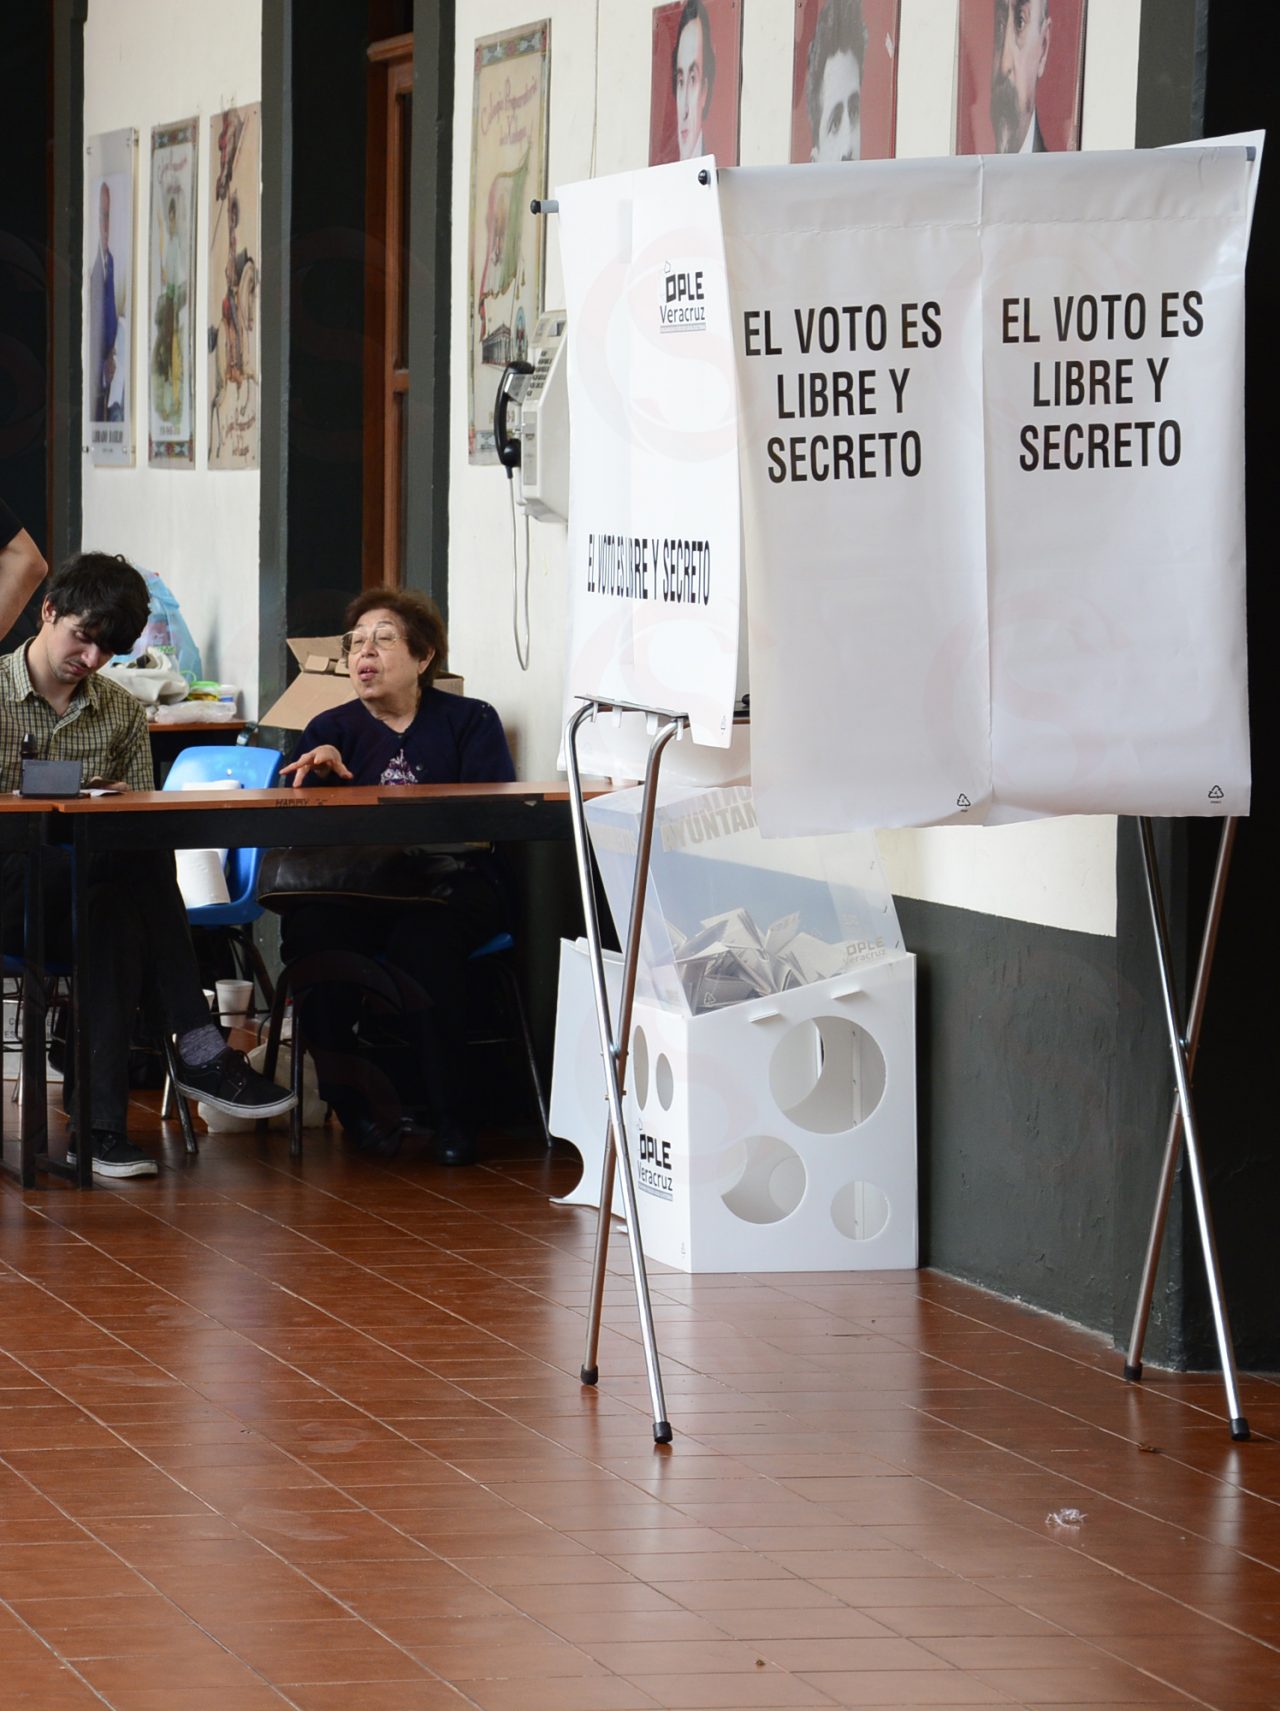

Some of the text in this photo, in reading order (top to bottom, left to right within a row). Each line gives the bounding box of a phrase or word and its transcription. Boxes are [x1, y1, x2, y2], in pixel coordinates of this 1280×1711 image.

[666, 271, 705, 303] OPLE
[660, 305, 705, 323] Veracruz
[744, 301, 942, 356] EL VOTO ES
[1002, 290, 1204, 344] EL VOTO ES
[777, 367, 911, 419] LIBRE Y
[1033, 357, 1170, 407] LIBRE Y
[767, 430, 922, 484] SECRETO
[1019, 419, 1181, 472] SECRETO
[651, 539, 660, 600] Y
[663, 538, 711, 605] SECRETO
[637, 1160, 673, 1191] Veracruz
[640, 1134, 672, 1170] OPLE
